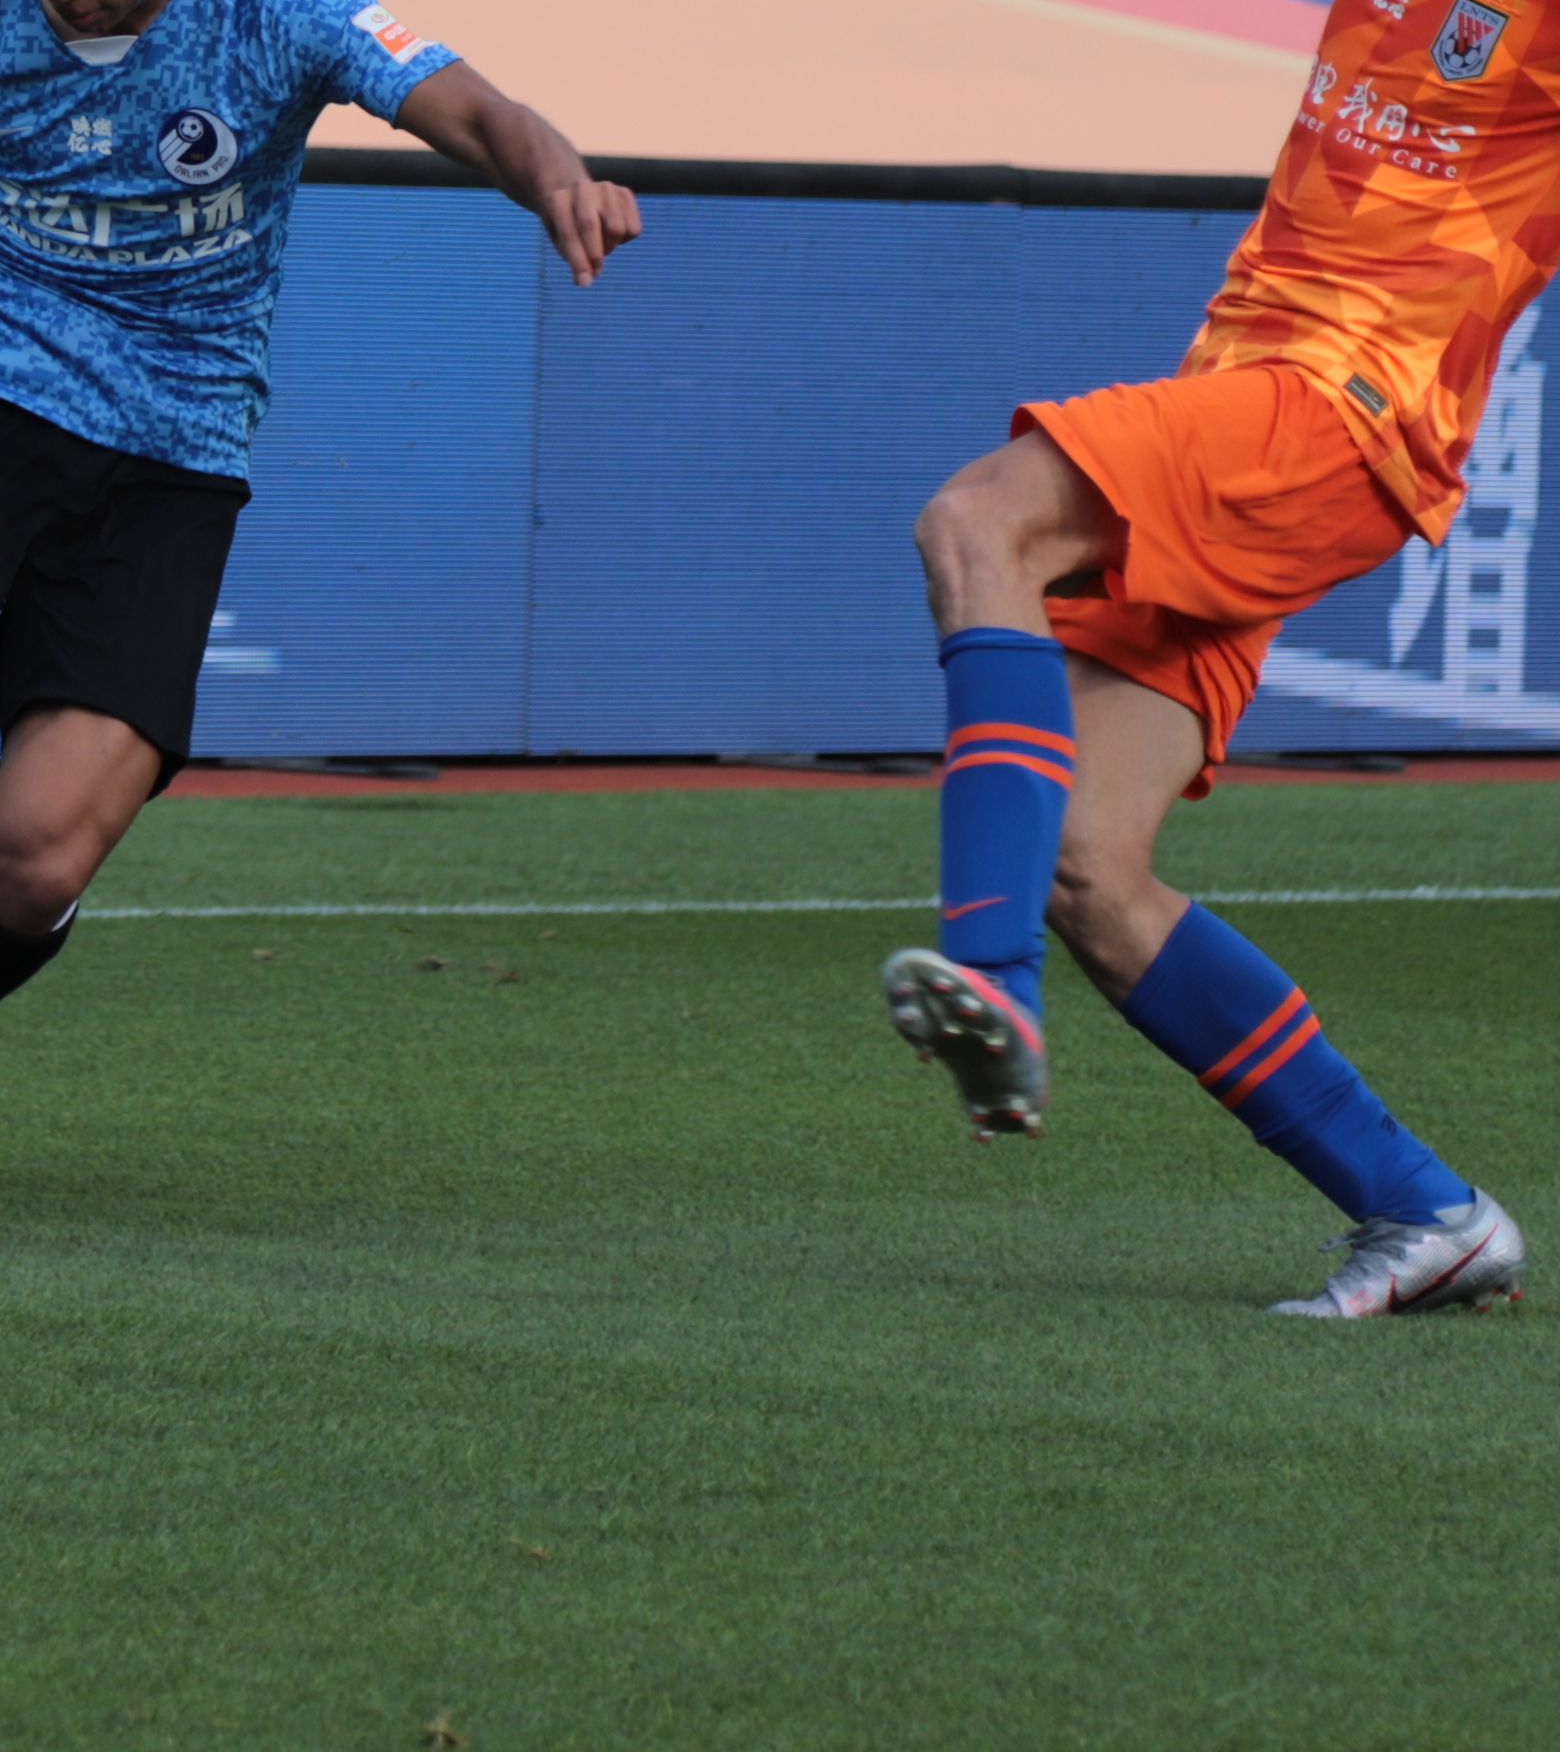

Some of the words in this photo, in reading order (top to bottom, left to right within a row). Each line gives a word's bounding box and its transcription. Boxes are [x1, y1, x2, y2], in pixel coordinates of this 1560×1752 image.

[1460, 2, 1500, 26] LNTS
[1295, 110, 1326, 134] wer
[1336, 127, 1382, 156] Our
[1391, 148, 1458, 179] Care
[173, 164, 210, 179] DALIAN
[108, 228, 253, 266] PLAZA
